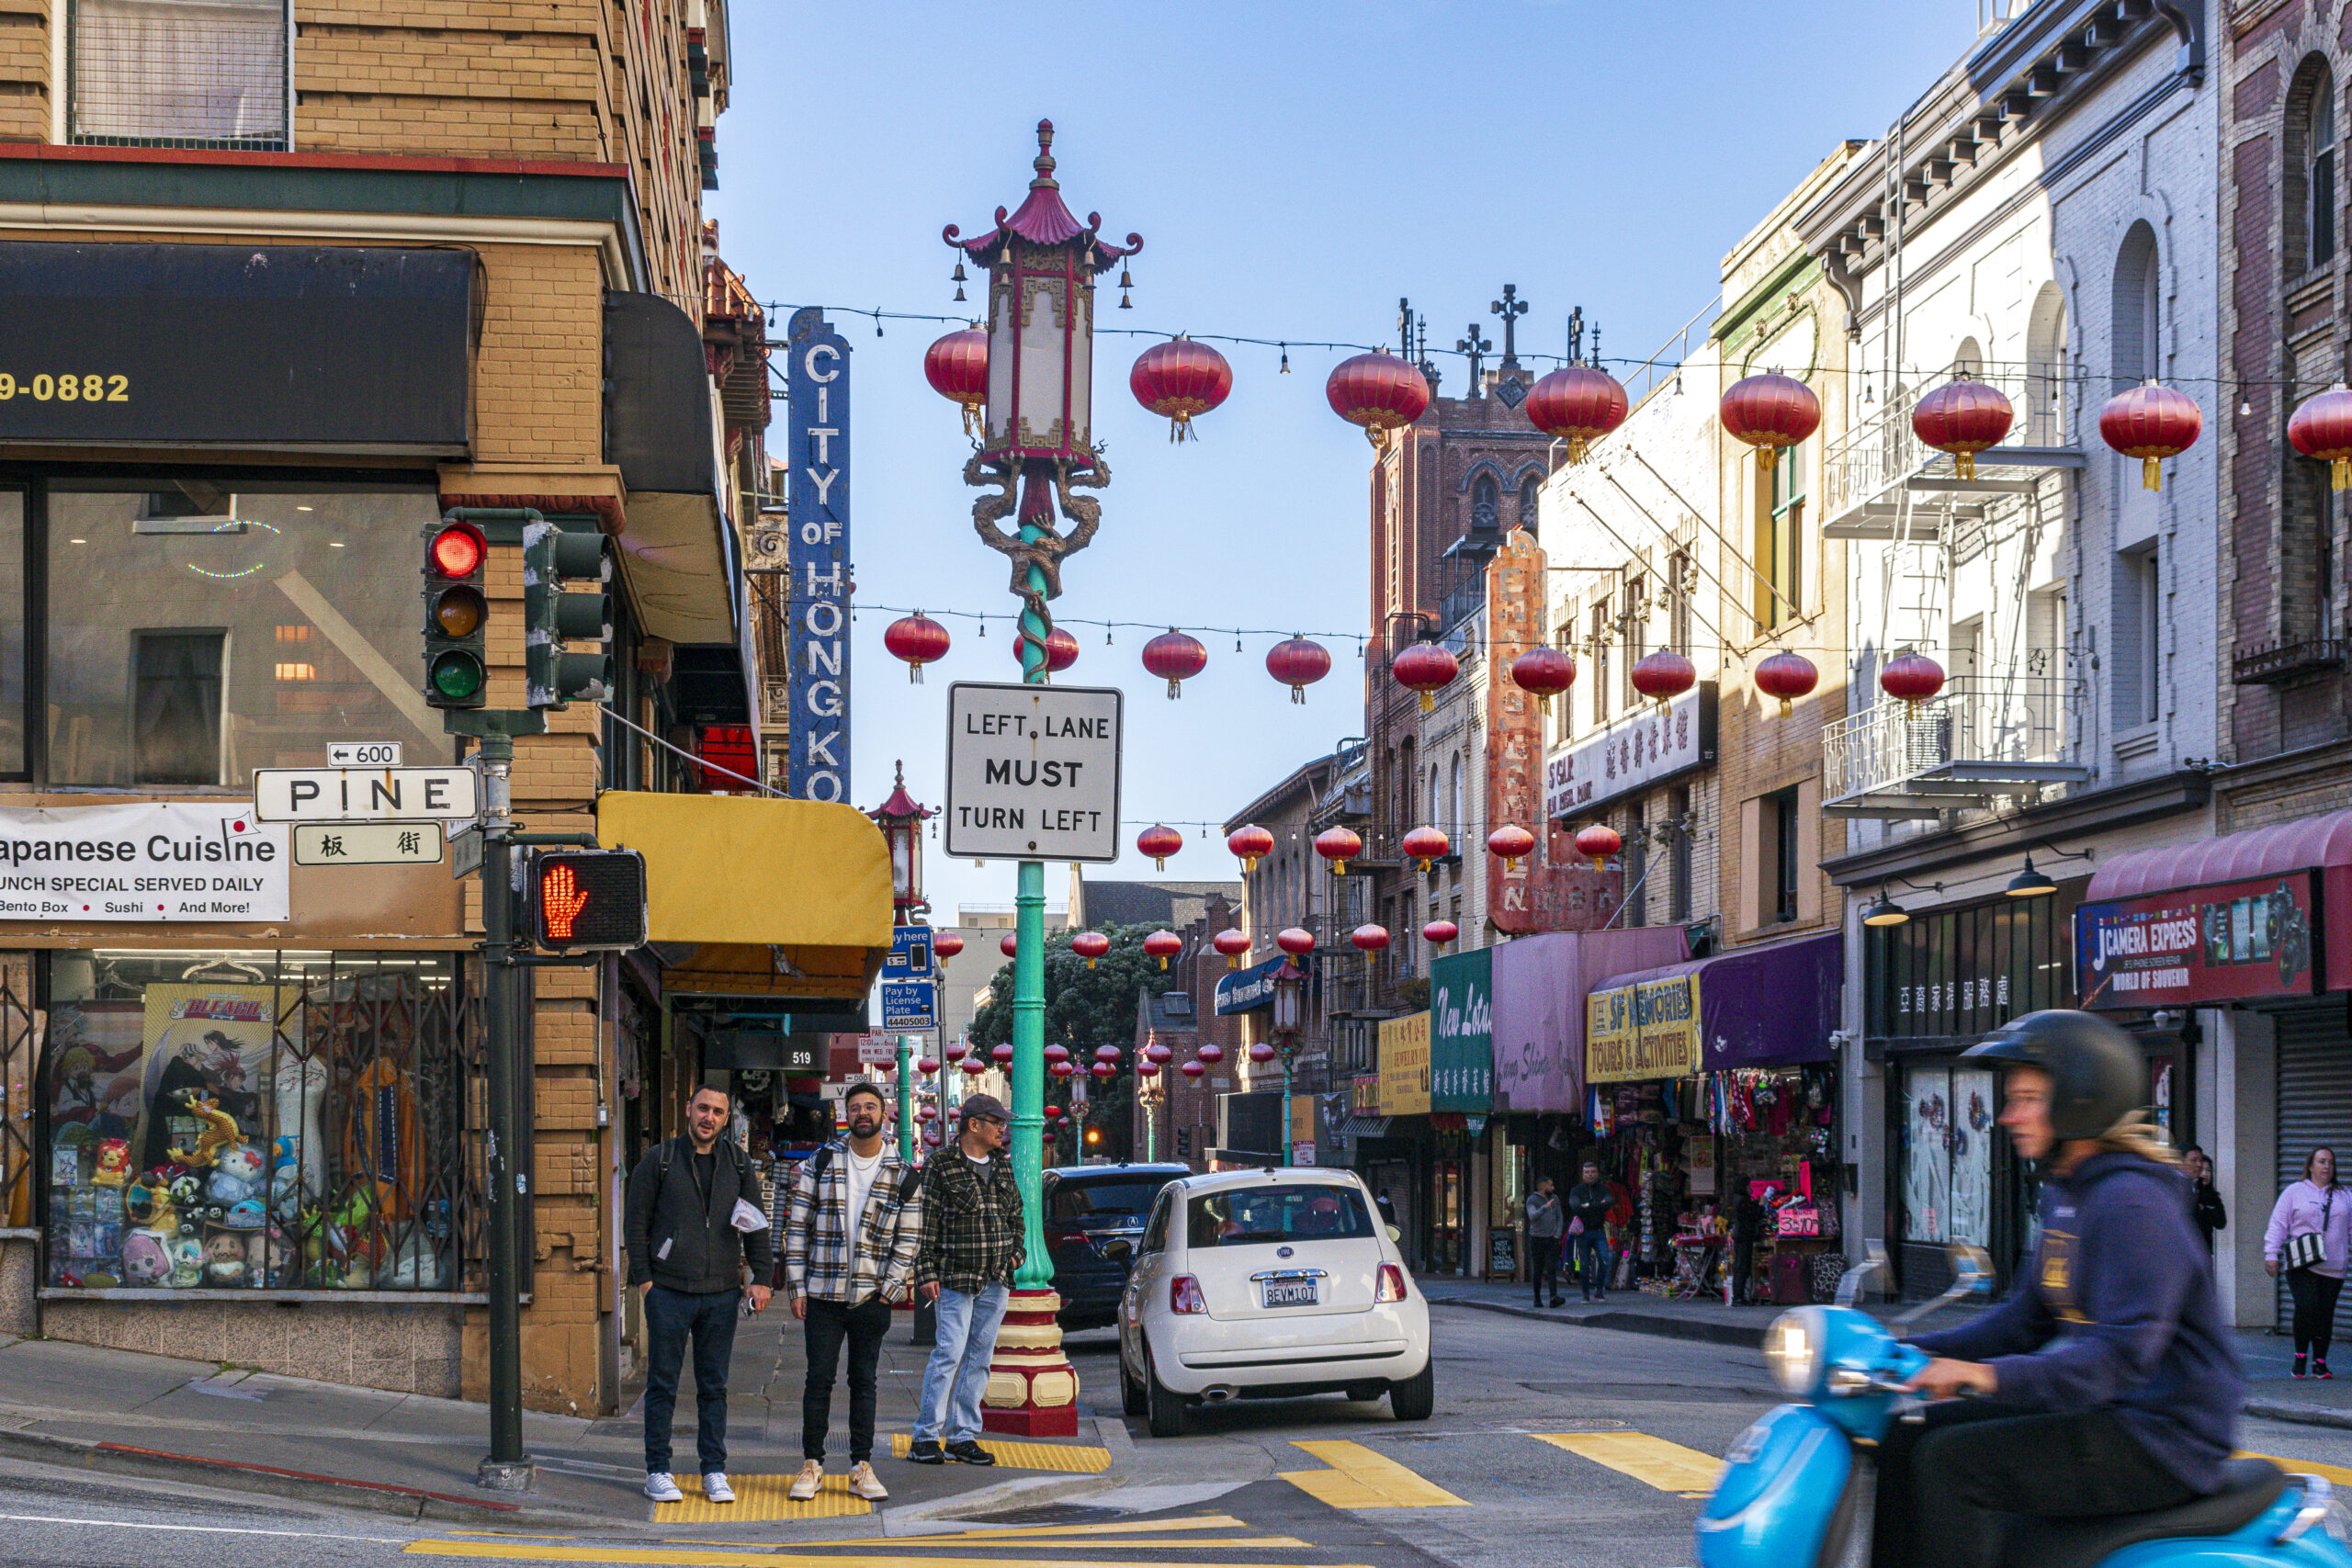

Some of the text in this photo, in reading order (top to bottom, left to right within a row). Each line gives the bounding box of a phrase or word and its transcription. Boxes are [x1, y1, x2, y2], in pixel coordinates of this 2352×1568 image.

[0, 373, 129, 401] 9-0882
[806, 344, 841, 504] CITY
[801, 522, 842, 544] OF
[807, 561, 842, 716] HONG
[967, 713, 1109, 739] LEFT LANE
[356, 746, 392, 762] 600
[986, 758, 1083, 788] MUST
[290, 778, 451, 812] PINE
[958, 807, 1102, 832] TURN LEFT
[147, 834, 276, 862] Cuisine
[51, 877, 130, 892] SPECIAL
[134, 877, 207, 892] SERVED
[212, 877, 265, 891] DAILY
[41, 901, 69, 912] Box
[105, 901, 143, 913] Sushi
[179, 901, 207, 913] And
[210, 901, 250, 913] More!
[903, 931, 928, 942] here
[2106, 925, 2148, 956] CAMERA
[2151, 917, 2197, 952] EXPRESS
[2113, 967, 2189, 991] WORLD OF SOUVENIR
[885, 986, 918, 997] Pay by
[886, 996, 922, 1005] License
[187, 998, 261, 1016] BLEACH
[886, 1006, 910, 1015] Plate
[1437, 986, 1460, 1039] New
[1610, 993, 1625, 1031] SF
[887, 1017, 930, 1026] 44405003
[792, 1051, 811, 1064] 519
[1591, 1039, 1623, 1073] TOURS
[1625, 1039, 1634, 1071] &
[1635, 1031, 1689, 1070] ACTIVITIES
[1267, 1287, 1315, 1303] 8EVM107
